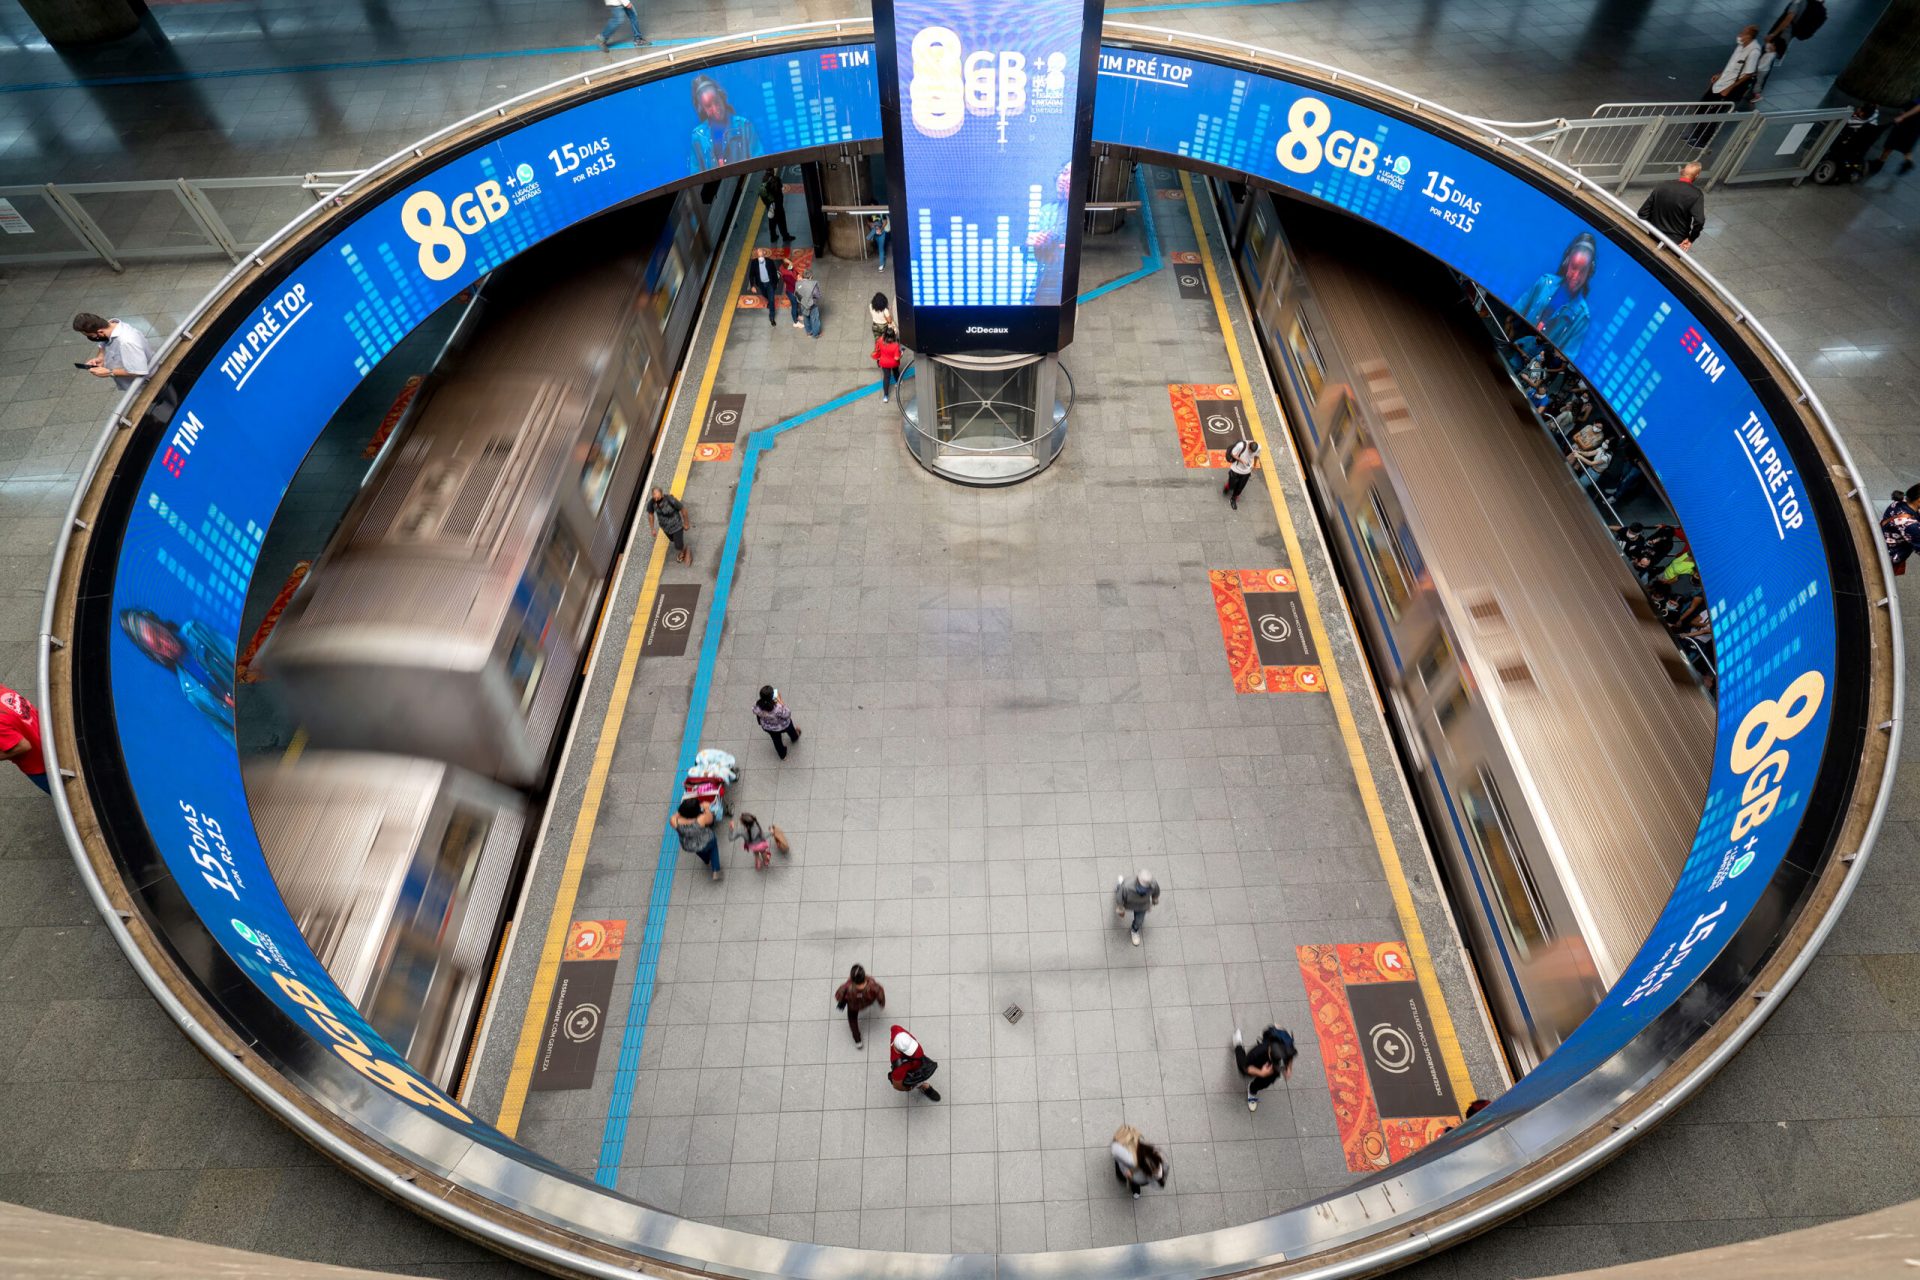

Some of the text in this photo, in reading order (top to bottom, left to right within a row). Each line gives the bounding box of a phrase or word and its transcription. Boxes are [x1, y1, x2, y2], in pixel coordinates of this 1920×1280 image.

[838, 50, 869, 67] TIM
[1126, 57, 1157, 76] PRÉ
[1161, 63, 1192, 81] TOP
[548, 137, 611, 176] 15 DIAS
[586, 154, 616, 178] R$15
[1422, 171, 1482, 215] 15 DIAS
[1443, 210, 1475, 233] R$15
[220, 283, 306, 382] TIM PRÉ TOP
[1694, 342, 1726, 384] TIM
[172, 410, 204, 455] TIM
[1741, 411, 1804, 530] TIM PRÉ TOP
[180, 800, 240, 901] 15 DIAS
[201, 813, 235, 866] R$15
[1645, 900, 1728, 996] 15 DIAS
[1622, 961, 1666, 1006] R$15
[542, 979, 569, 1072] DESEMBARQUE COM GENTILEZA
[1409, 998, 1442, 1096] DESEMBARQUE COM GENTILEZA
